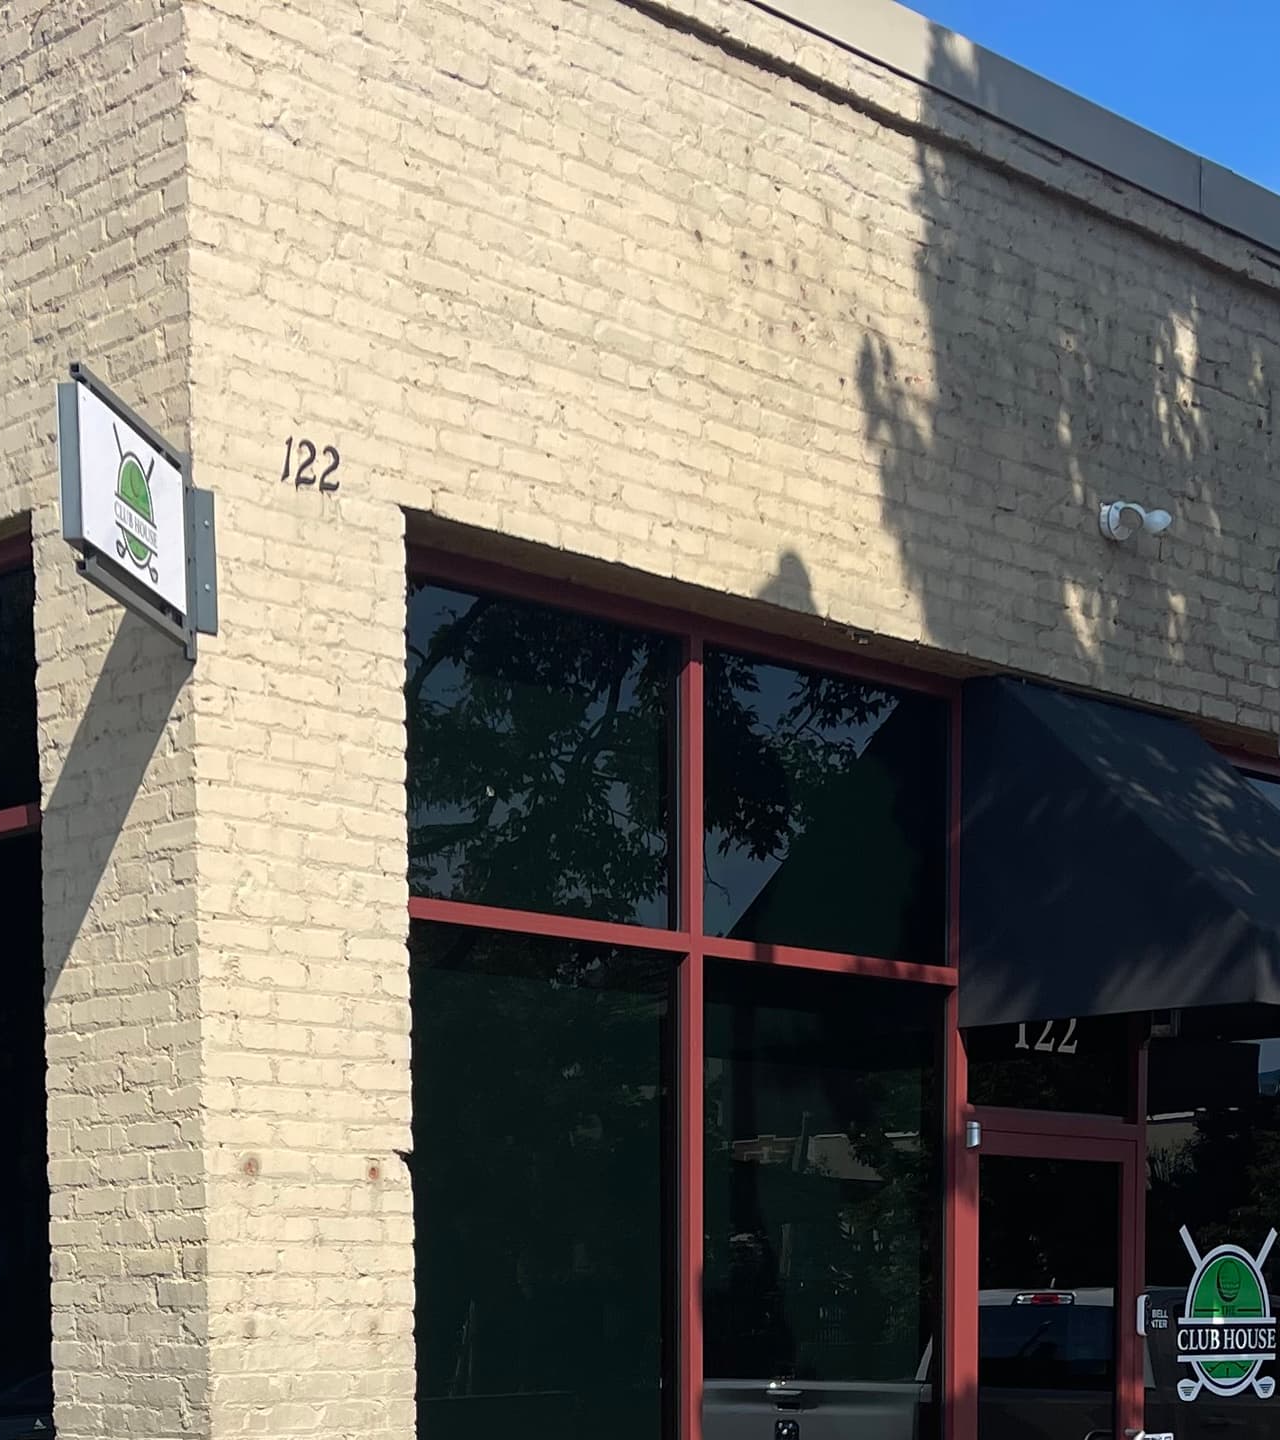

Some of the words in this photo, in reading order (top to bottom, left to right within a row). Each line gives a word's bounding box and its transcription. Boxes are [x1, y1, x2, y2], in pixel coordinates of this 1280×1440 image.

[280, 435, 339, 495] 122
[114, 500, 134, 528] CLUB
[134, 516, 158, 549] HOUSE
[1177, 1328, 1220, 1351] CLUB
[1222, 1328, 1277, 1350] HOUSE
